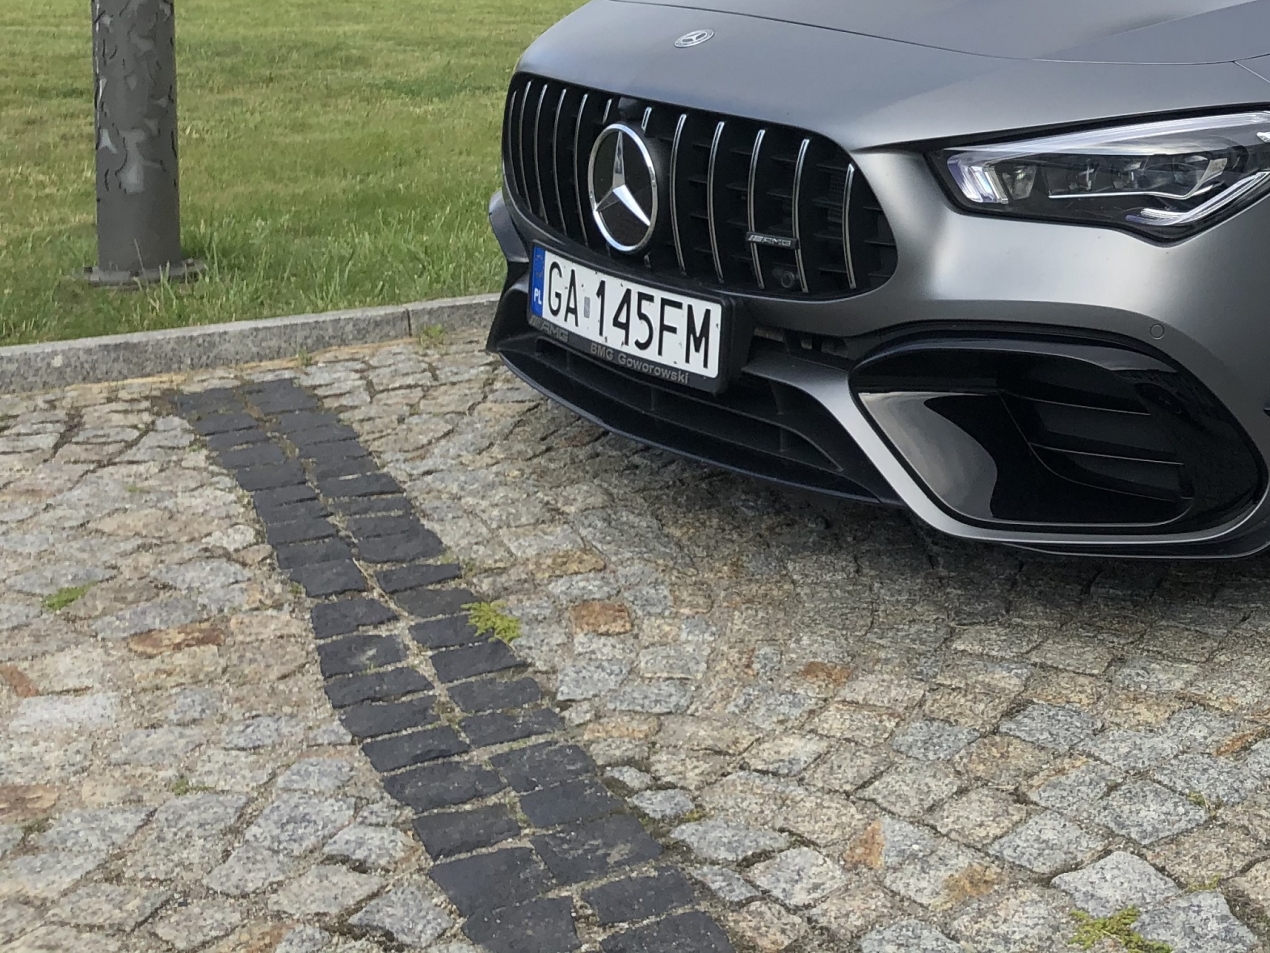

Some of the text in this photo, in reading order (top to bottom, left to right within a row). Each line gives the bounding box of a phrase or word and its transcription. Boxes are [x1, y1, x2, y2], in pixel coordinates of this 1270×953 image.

[762, 237, 792, 248] AMG
[533, 287, 543, 305] PL
[548, 261, 711, 369] GA 145FM
[541, 321, 570, 343] AMG
[590, 343, 689, 385] BMG Goworowski
